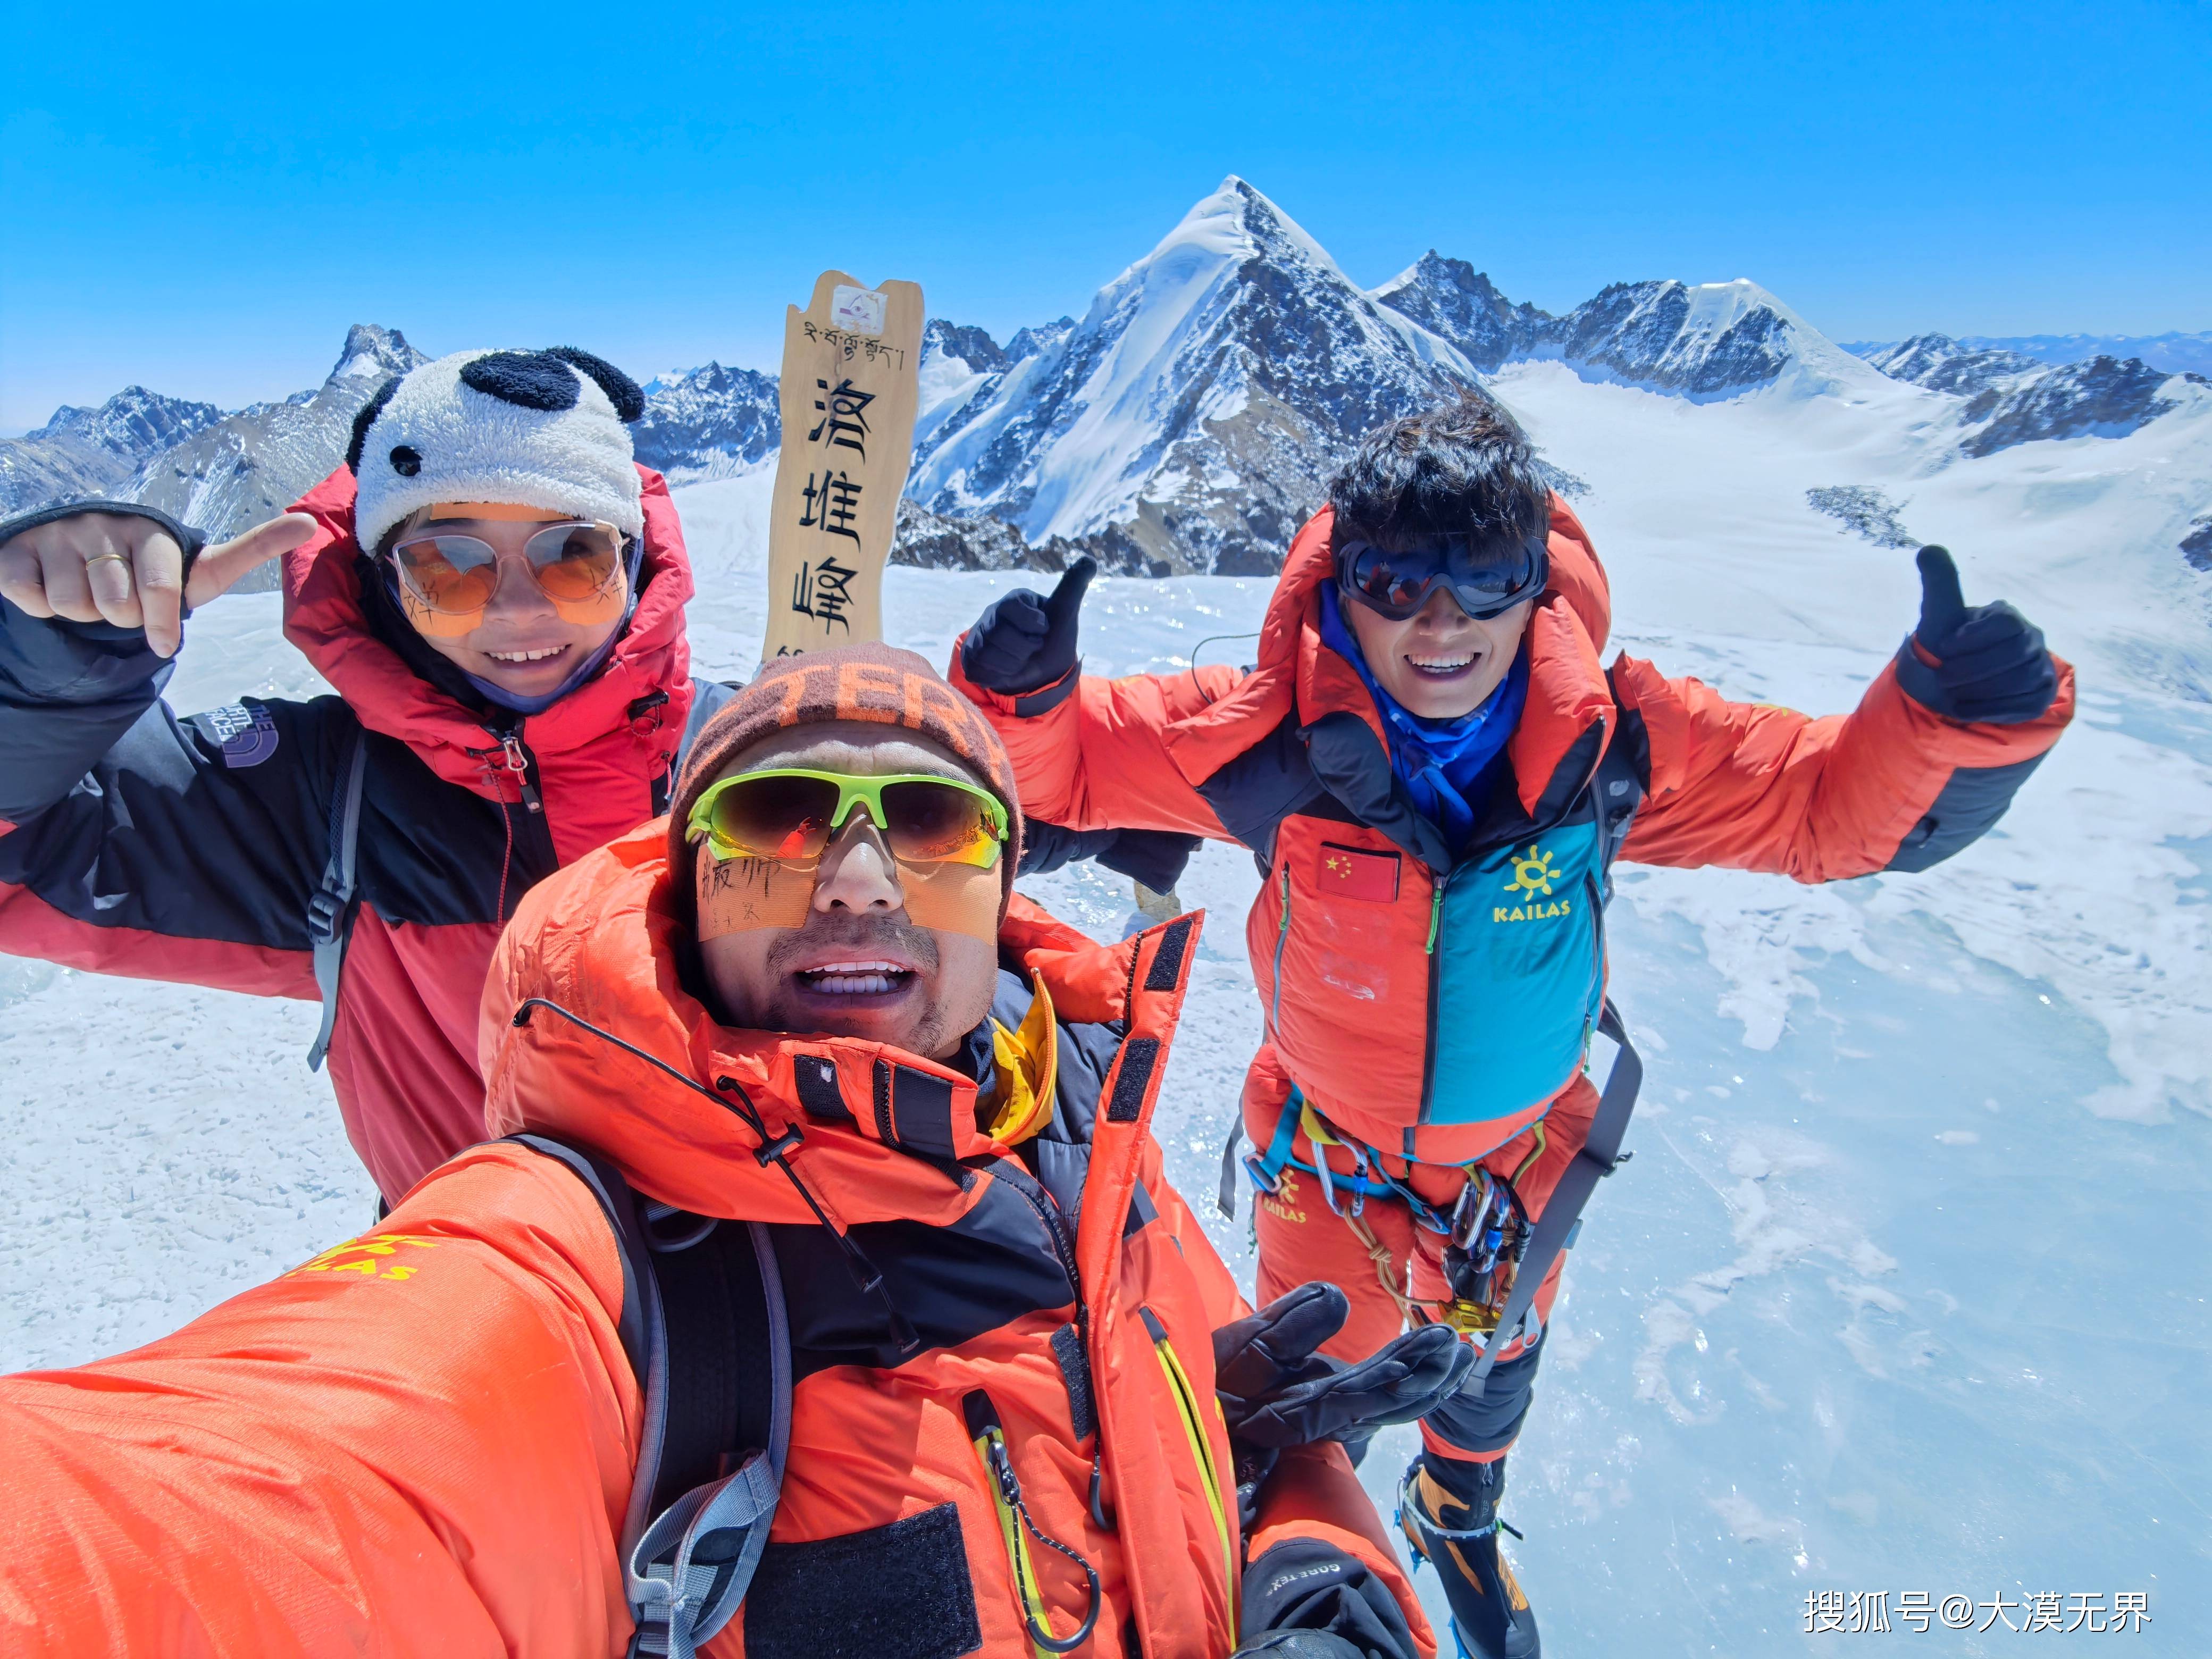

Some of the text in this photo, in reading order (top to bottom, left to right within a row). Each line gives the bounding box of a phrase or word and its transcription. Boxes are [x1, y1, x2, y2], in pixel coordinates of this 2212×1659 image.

[792, 378, 877, 636] 洛堆峰
[248, 704, 276, 732] THE
[1493, 899, 1571, 923] KAILAS
[1262, 1196, 1306, 1224] KAILAS
